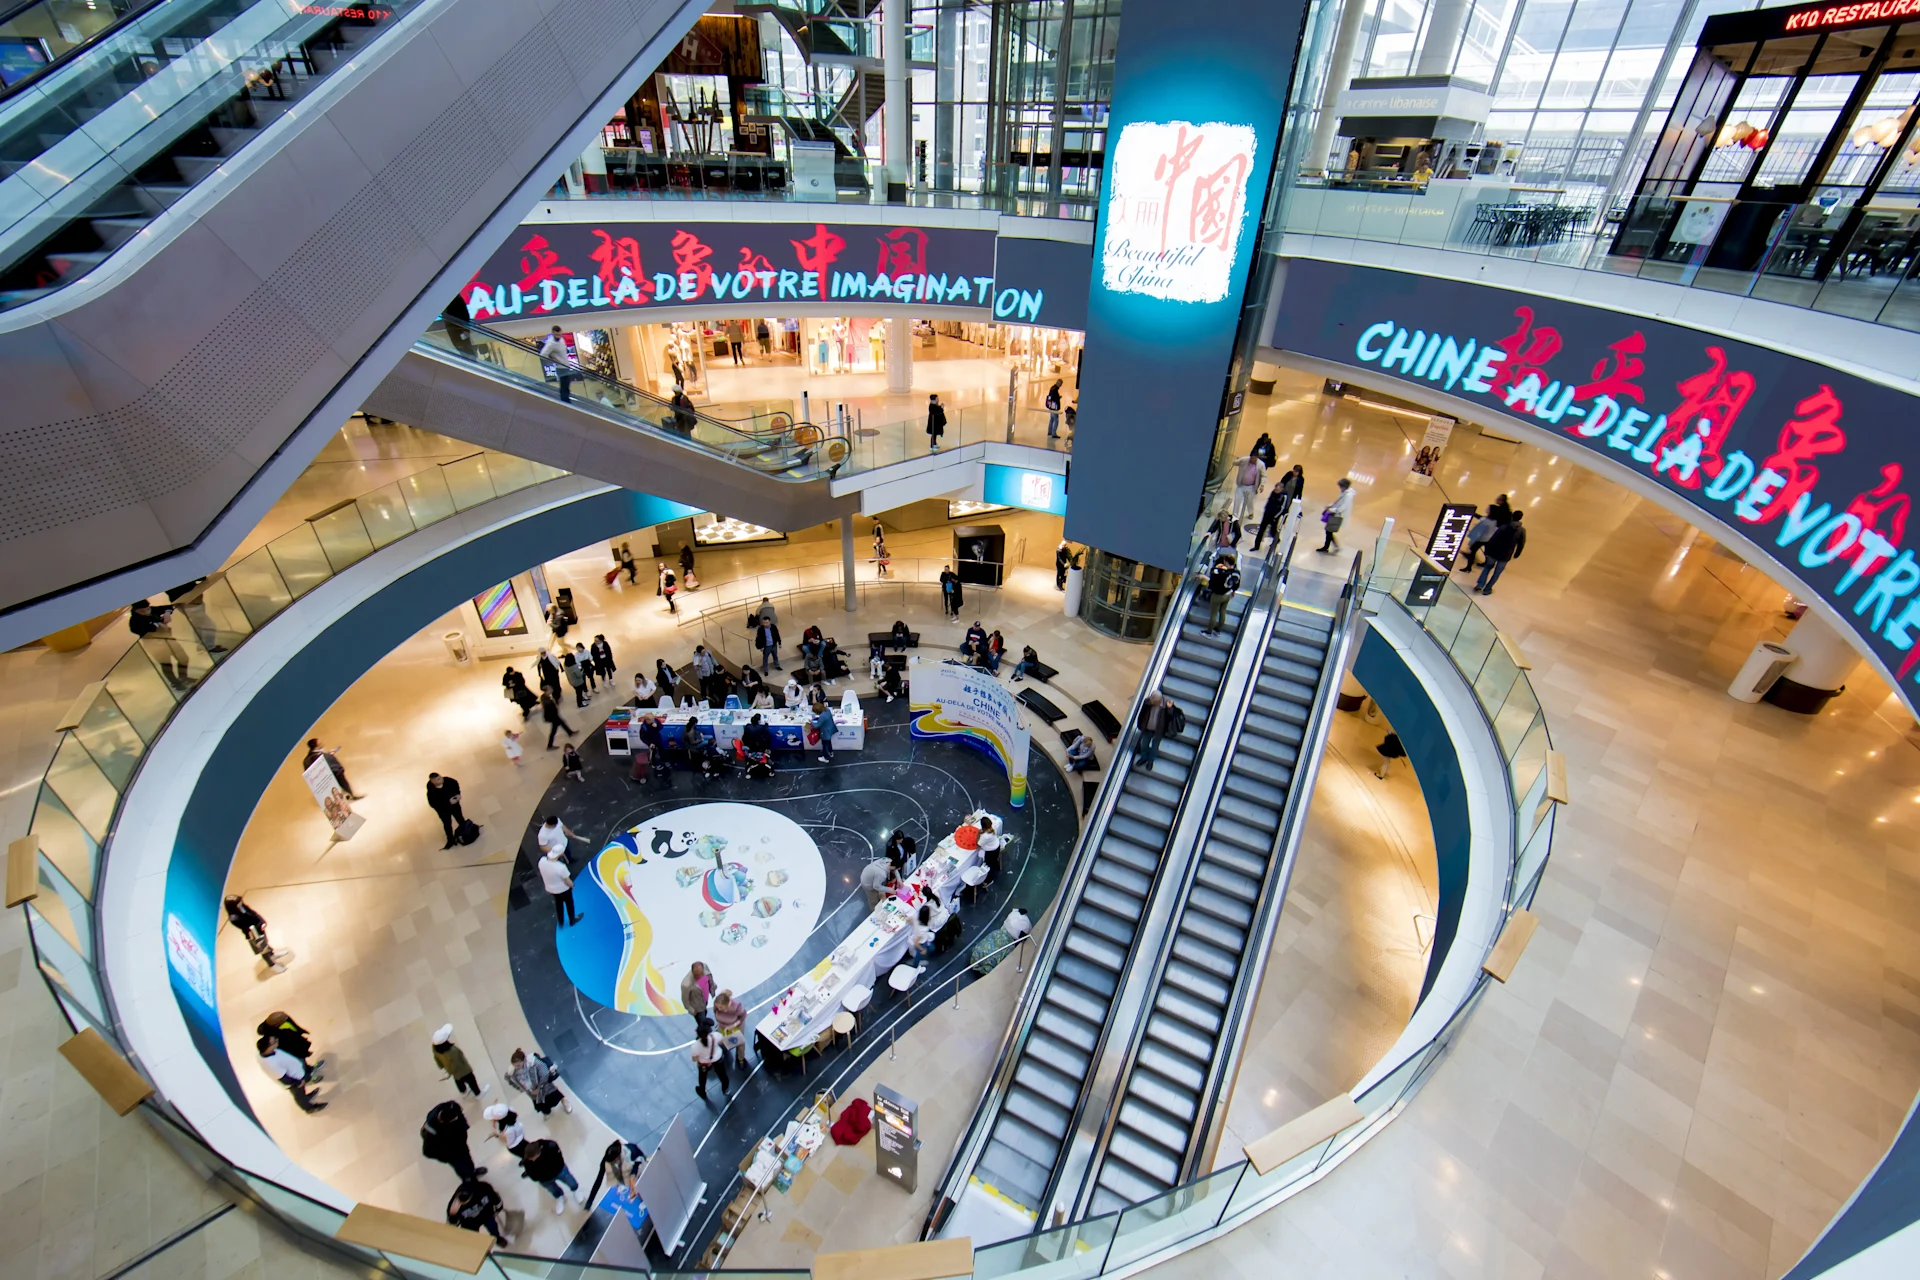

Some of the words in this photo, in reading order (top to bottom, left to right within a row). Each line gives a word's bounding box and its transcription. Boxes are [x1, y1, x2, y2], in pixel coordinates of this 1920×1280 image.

[1785, 10, 1819, 30] K10
[1389, 95, 1439, 109] libanaise
[1107, 238, 1206, 271] Beautiful
[1117, 265, 1175, 288] China
[466, 266, 640, 320] AU-DELÀ
[652, 271, 698, 302] DE
[711, 268, 820, 300] VOTRE
[831, 270, 1044, 322] IMAGINATON
[1356, 319, 1508, 393] CHINE
[1504, 372, 1711, 482] AU-DELÀ
[1704, 450, 1788, 521] DE
[966, 704, 976, 712] DE
[976, 708, 995, 722] VOTRE
[972, 698, 1001, 721] CHINE
